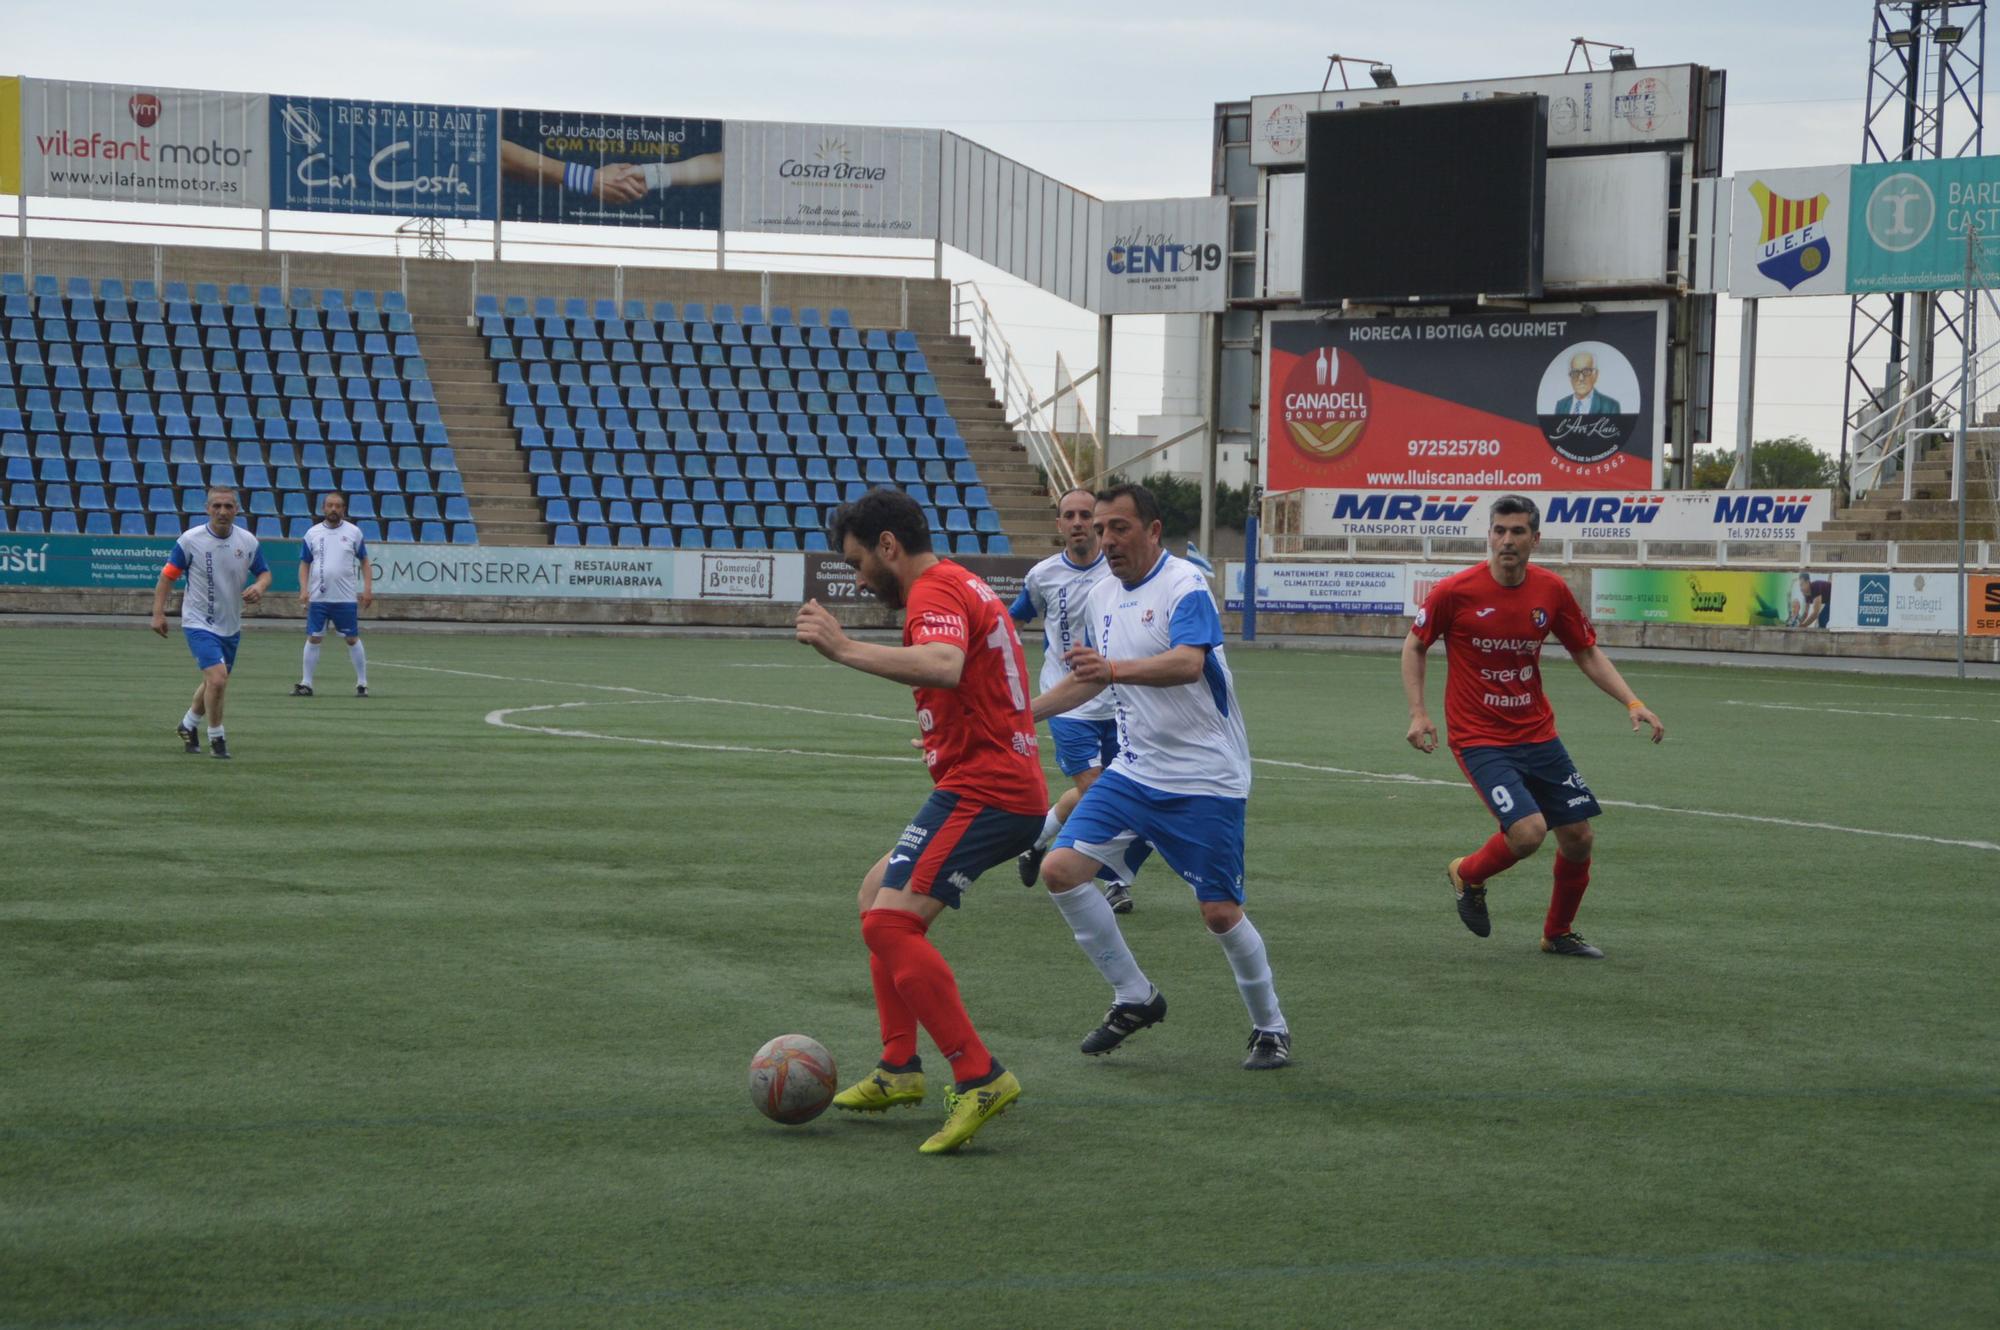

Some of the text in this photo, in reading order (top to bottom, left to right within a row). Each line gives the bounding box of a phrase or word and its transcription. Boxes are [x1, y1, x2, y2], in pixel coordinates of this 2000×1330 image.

[337, 106, 486, 131] RESTAURANT
[566, 126, 623, 140] JUGADOR
[626, 127, 639, 141] ÉS
[643, 129, 664, 142] TAN
[36, 130, 252, 167] vilafant motor
[546, 138, 680, 156] COM TOTS JUNTS
[297, 141, 470, 195] Can Costa
[833, 162, 886, 181] Brava
[51, 171, 237, 193] www.vilafantmotor.es
[1349, 322, 1567, 341] HORECA I BOTIGA GOURMET
[1285, 392, 1367, 410] CANADELL
[1285, 409, 1367, 421] gourmand
[1408, 440, 1501, 457] 972525780
[1551, 455, 1625, 475] Des de 1962
[1366, 469, 1542, 486] www.lluiscanadell.com
[1332, 494, 1479, 521] MRW
[1545, 495, 1664, 523] MRW
[1713, 495, 1813, 523] MRW
[1342, 523, 1468, 535] TRANSPORT URGENT
[1582, 527, 1631, 538] FIGUERES
[1728, 528, 1795, 538] Tel. 972 67 55 55
[391, 561, 562, 584] MONTSERRAT
[574, 560, 653, 572] RESTAURANT
[716, 560, 761, 573] Comercial
[569, 575, 663, 587] EMPURIABRAVA
[710, 572, 765, 589] Borrell
[1284, 579, 1386, 588] CLIMATITZACIÓ REPARACIÓ
[1356, 571, 1396, 579] COMERCIAL
[827, 582, 856, 597] 972
[1863, 593, 1884, 603] HOTEL
[1896, 595, 1905, 610] El
[1484, 692, 1531, 707] manxa
[1491, 785, 1514, 813] 9
